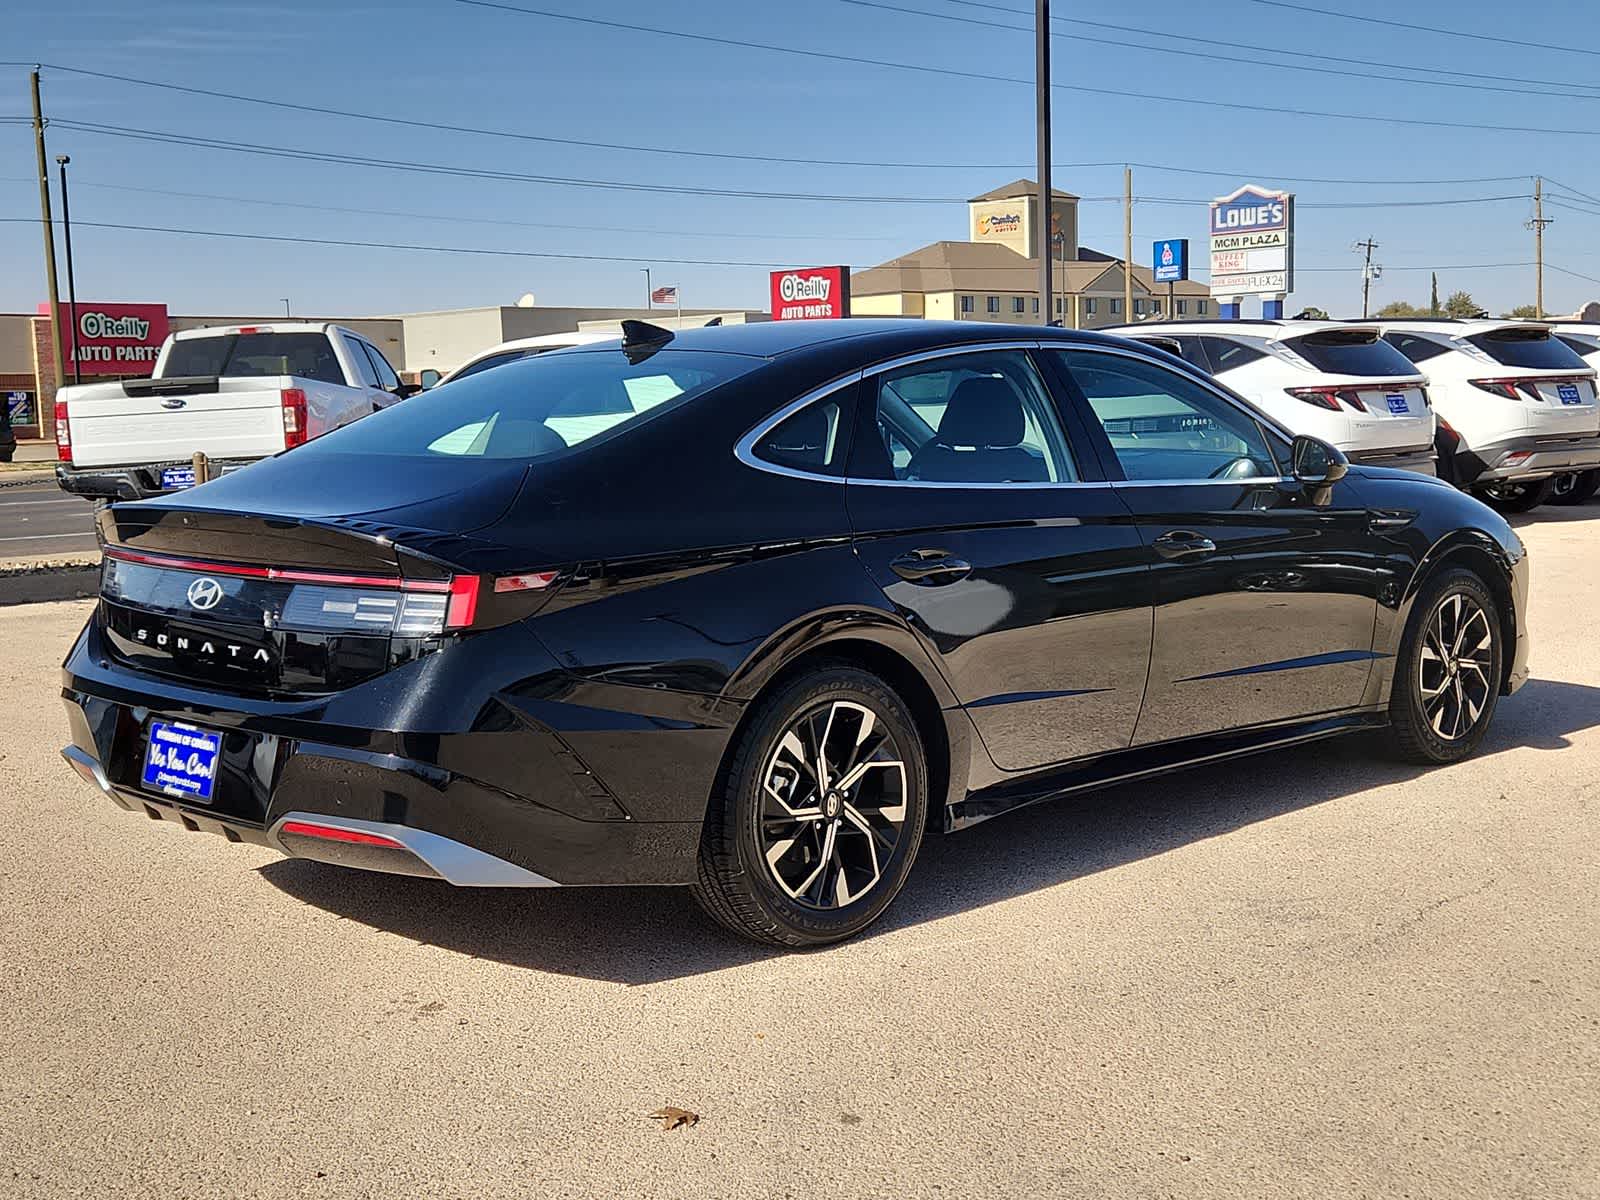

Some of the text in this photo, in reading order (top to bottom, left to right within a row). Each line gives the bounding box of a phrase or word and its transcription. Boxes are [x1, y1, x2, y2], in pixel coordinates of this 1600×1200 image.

[1215, 203, 1283, 229] LOWE'S
[1214, 234, 1281, 249] MCM PLAZA
[1214, 252, 1245, 261] BUFFET
[781, 275, 830, 301] O'Reilly
[781, 304, 832, 320] AUTO PARTS
[81, 313, 150, 340] O'Reilly
[71, 347, 112, 361] AUTO
[137, 628, 270, 663] SONATA
[150, 743, 217, 780] Yes You Can!
